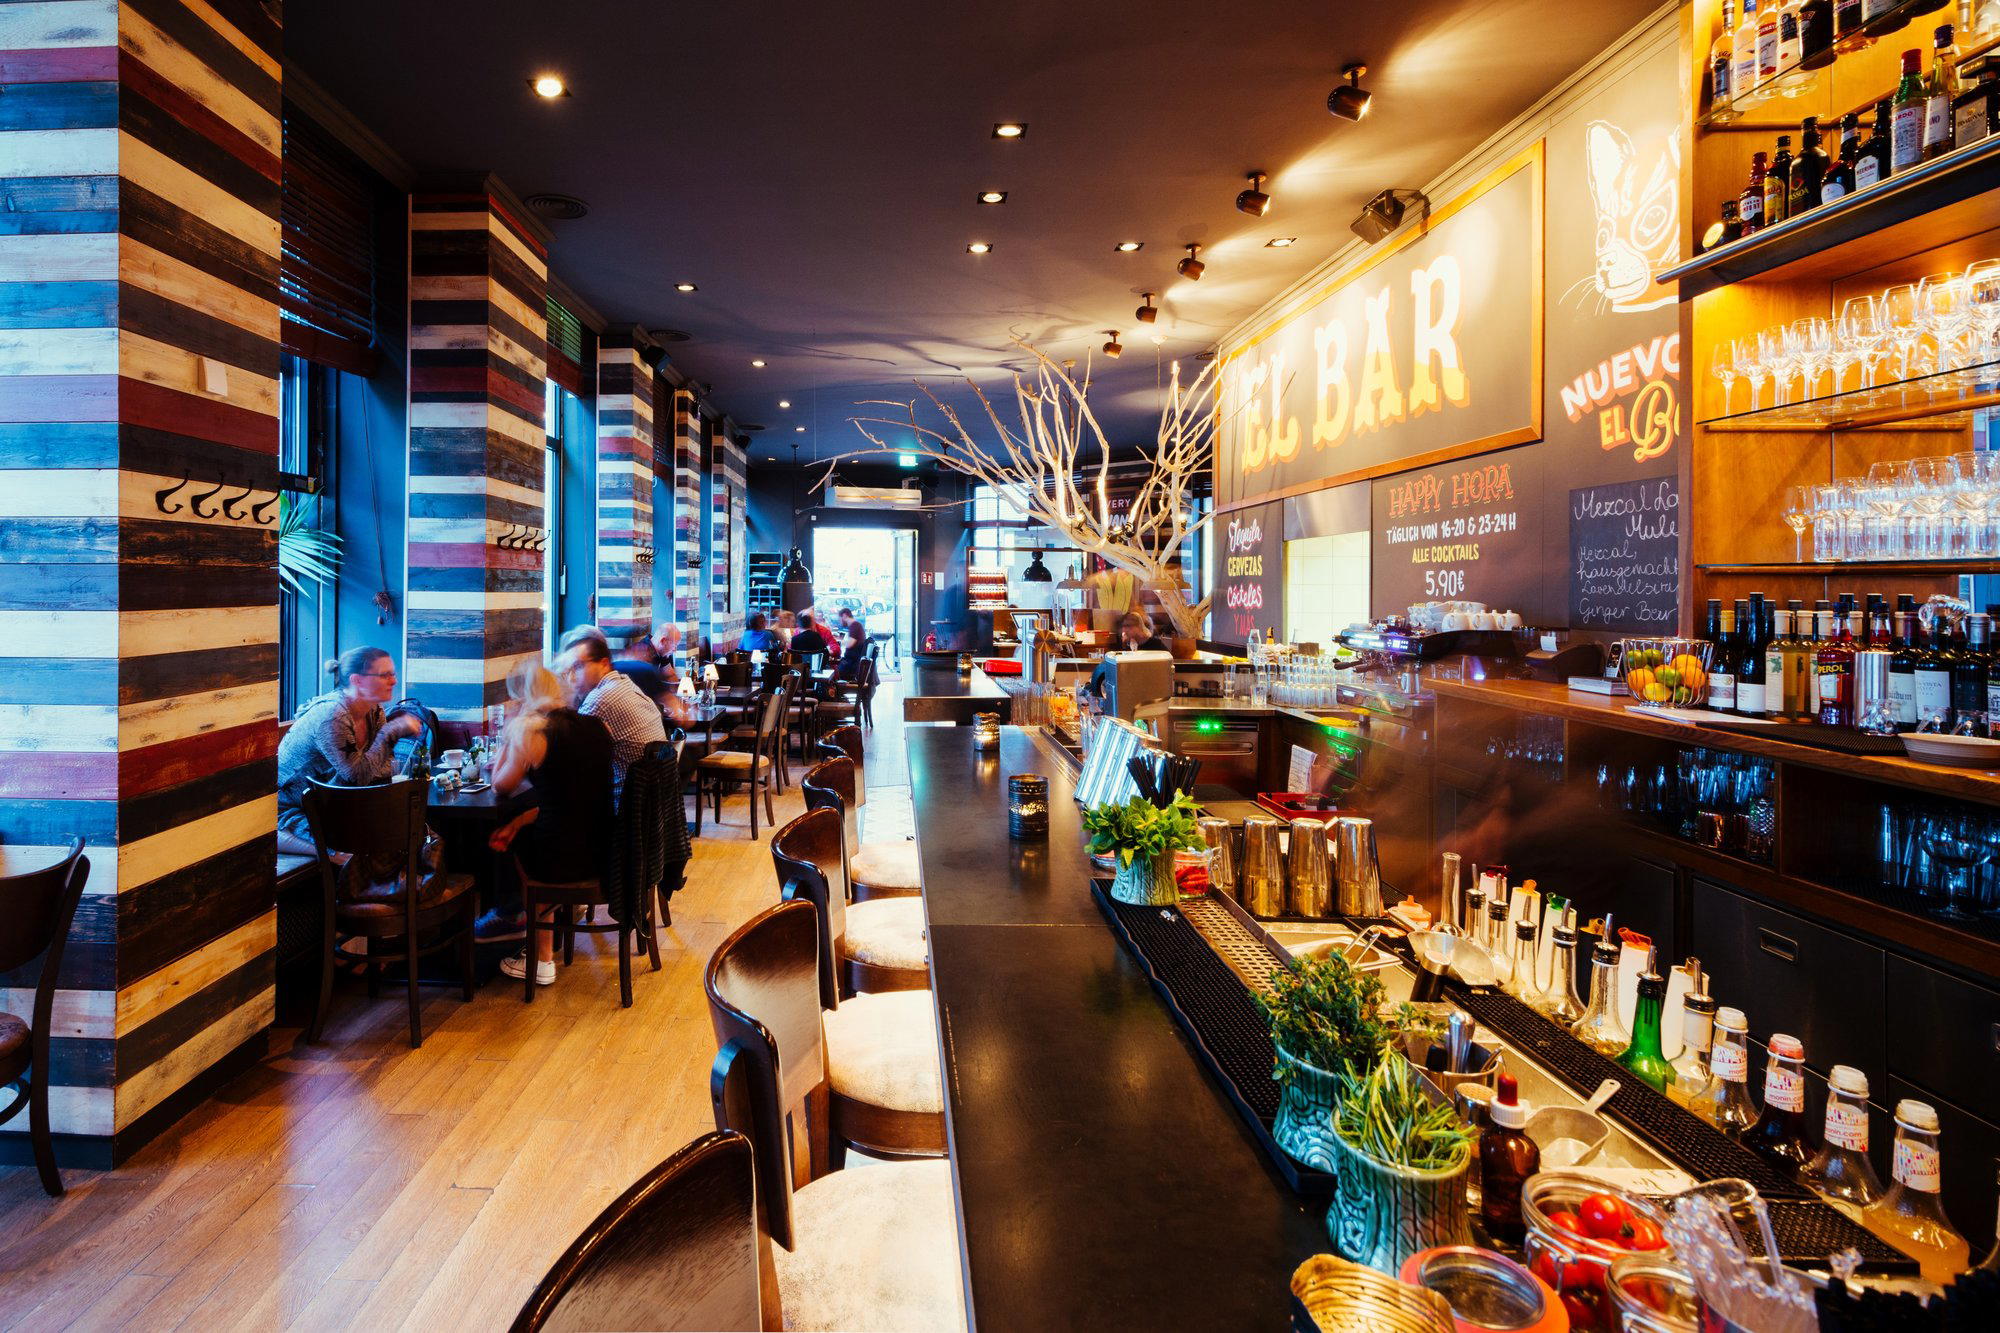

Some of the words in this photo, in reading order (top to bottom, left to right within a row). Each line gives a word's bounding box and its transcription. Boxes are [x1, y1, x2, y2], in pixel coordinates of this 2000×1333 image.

[1241, 350, 1302, 475] EL
[1312, 255, 1470, 451] BAR
[1599, 404, 1632, 450] EL
[1389, 473, 1445, 519] HAPPY
[1451, 463, 1515, 509] HORA
[1574, 485, 1652, 521] Mezcal
[1228, 518, 1263, 553] Tequila
[1386, 525, 1419, 545] TÄGLICH
[1421, 522, 1438, 541] VON
[1441, 518, 1465, 540] 16-20
[1467, 516, 1477, 536] &
[1478, 512, 1507, 536] 23-24
[1625, 514, 1679, 540] Mule
[1227, 554, 1263, 577] CERVEZAS
[1411, 547, 1430, 565] ALLE
[1431, 543, 1480, 564] COCKTAILS
[1425, 569, 1465, 597] 5,90€
[1234, 613, 1240, 635] Y
[1818, 664, 1845, 674] PEROL
